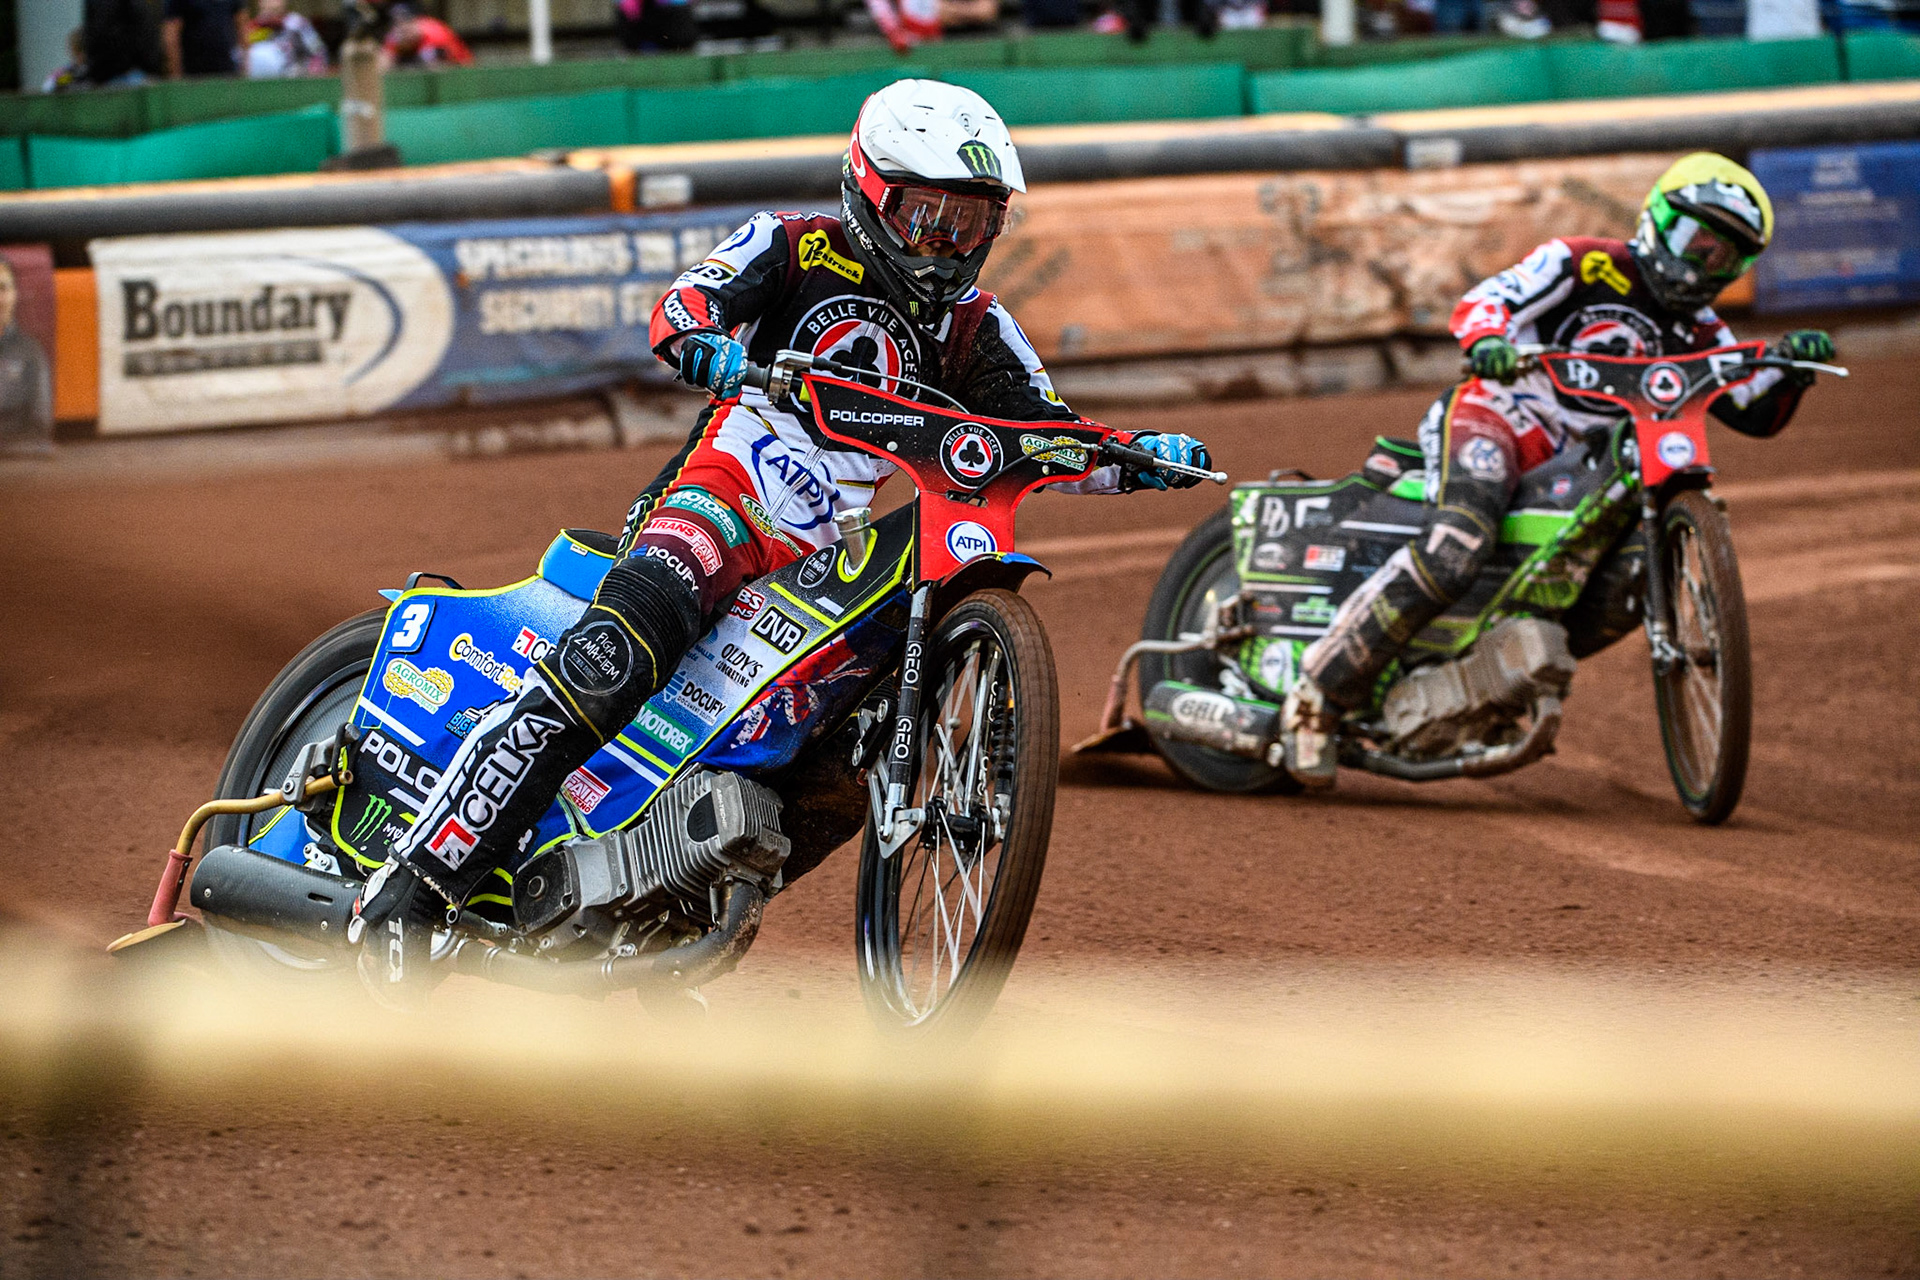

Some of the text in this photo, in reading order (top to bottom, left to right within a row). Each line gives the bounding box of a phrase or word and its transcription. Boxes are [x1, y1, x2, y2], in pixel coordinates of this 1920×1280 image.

[122, 279, 354, 342] Boundary
[806, 303, 917, 383] BELLE VUE ACES
[829, 409, 925, 427] POLCOPPER
[945, 426, 999, 454] BELLE VUE ACES
[1025, 437, 1081, 461] AGRMIX
[651, 519, 697, 537] TRANS
[671, 490, 738, 541] MOTOREX
[691, 502, 733, 544] Switzerland
[955, 535, 987, 553] ATPI
[645, 545, 700, 592] DOCUFY
[730, 604, 754, 618] INS
[736, 588, 763, 611] BS
[391, 603, 430, 648] 3
[595, 631, 617, 658] FIGA
[755, 610, 802, 652] DVR
[581, 640, 620, 681] MAKIEM
[715, 660, 750, 688] CONCRETING
[721, 643, 764, 678] OLDY'S
[904, 642, 922, 684] GEO
[392, 663, 444, 702] AGROMIX
[681, 681, 727, 718] DOCUFY
[636, 704, 692, 754] MOTOREX
[894, 717, 912, 759] GEO
[461, 714, 564, 830] CELKA
[564, 774, 601, 809] FAIR
